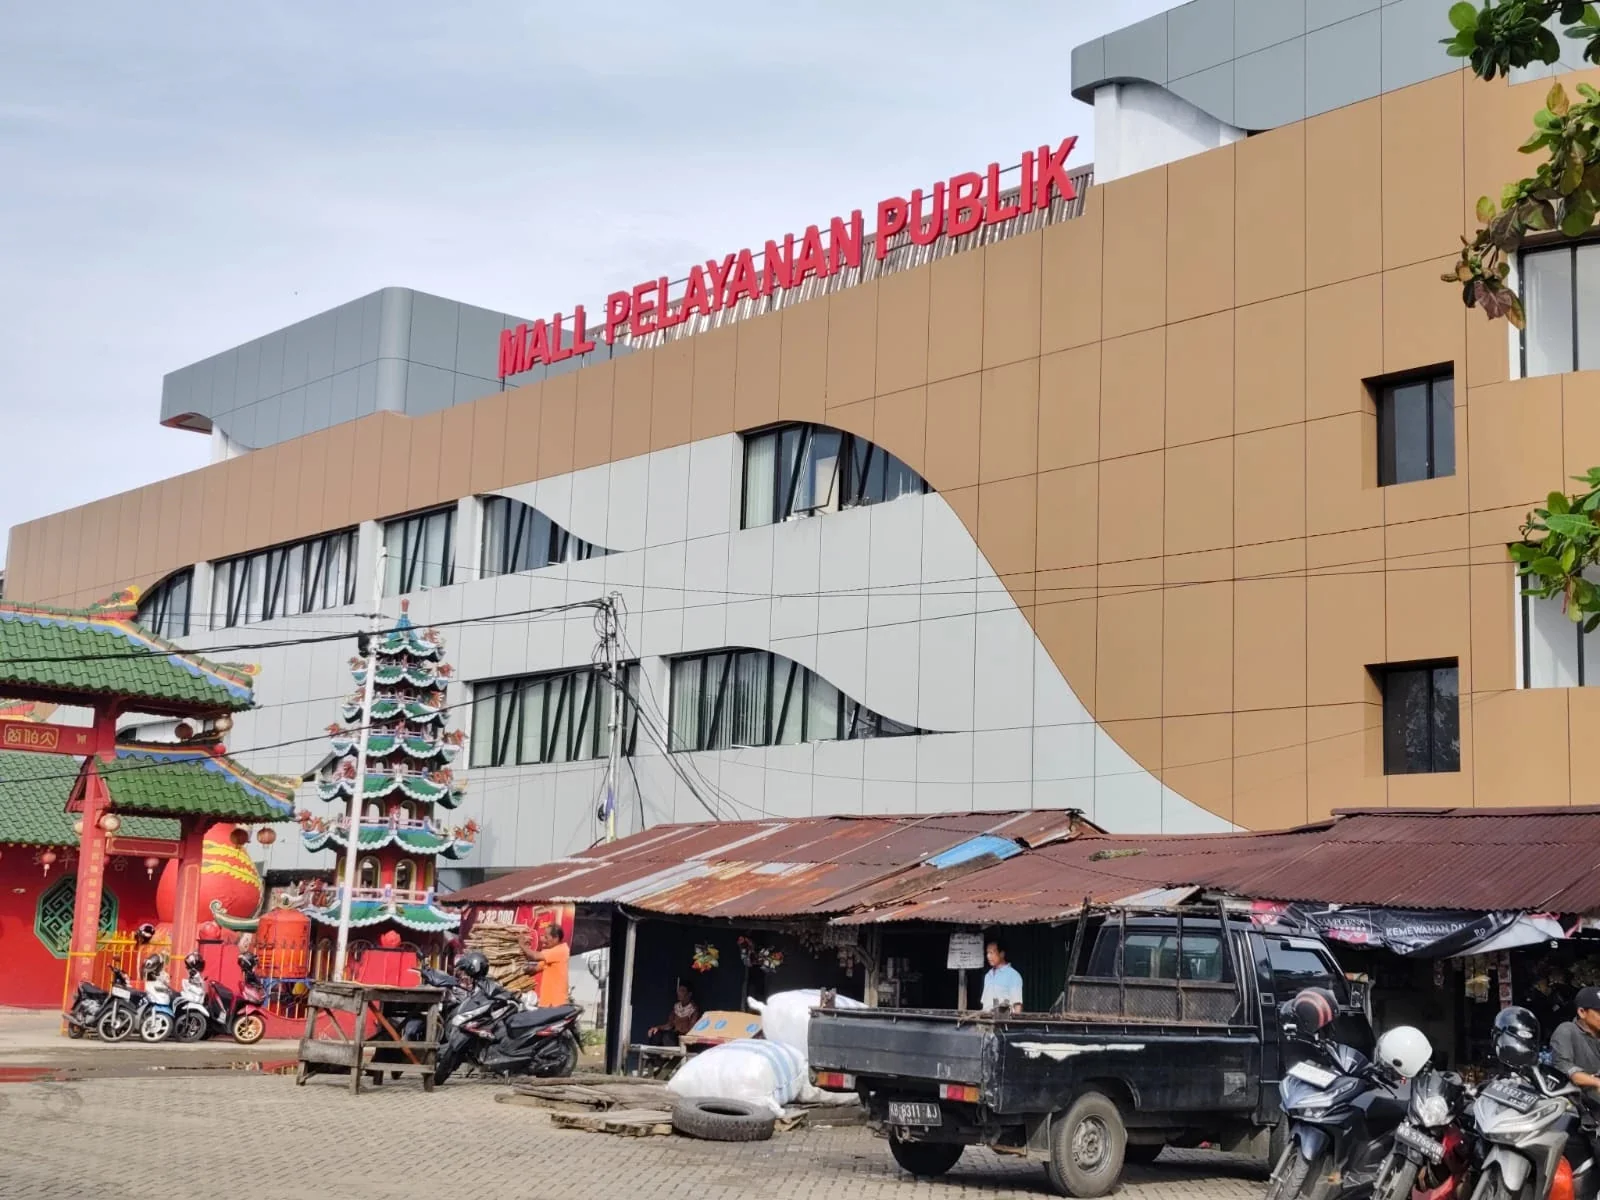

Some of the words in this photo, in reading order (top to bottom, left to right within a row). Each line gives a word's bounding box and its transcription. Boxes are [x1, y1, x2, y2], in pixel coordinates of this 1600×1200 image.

[498, 304, 595, 378] MALL
[606, 209, 864, 345] PELAYANAN
[876, 135, 1079, 260] PUBLIK
[1385, 924, 1450, 938] KEMEWAHAN
[890, 1103, 899, 1117] KB
[926, 1104, 938, 1119] AJ
